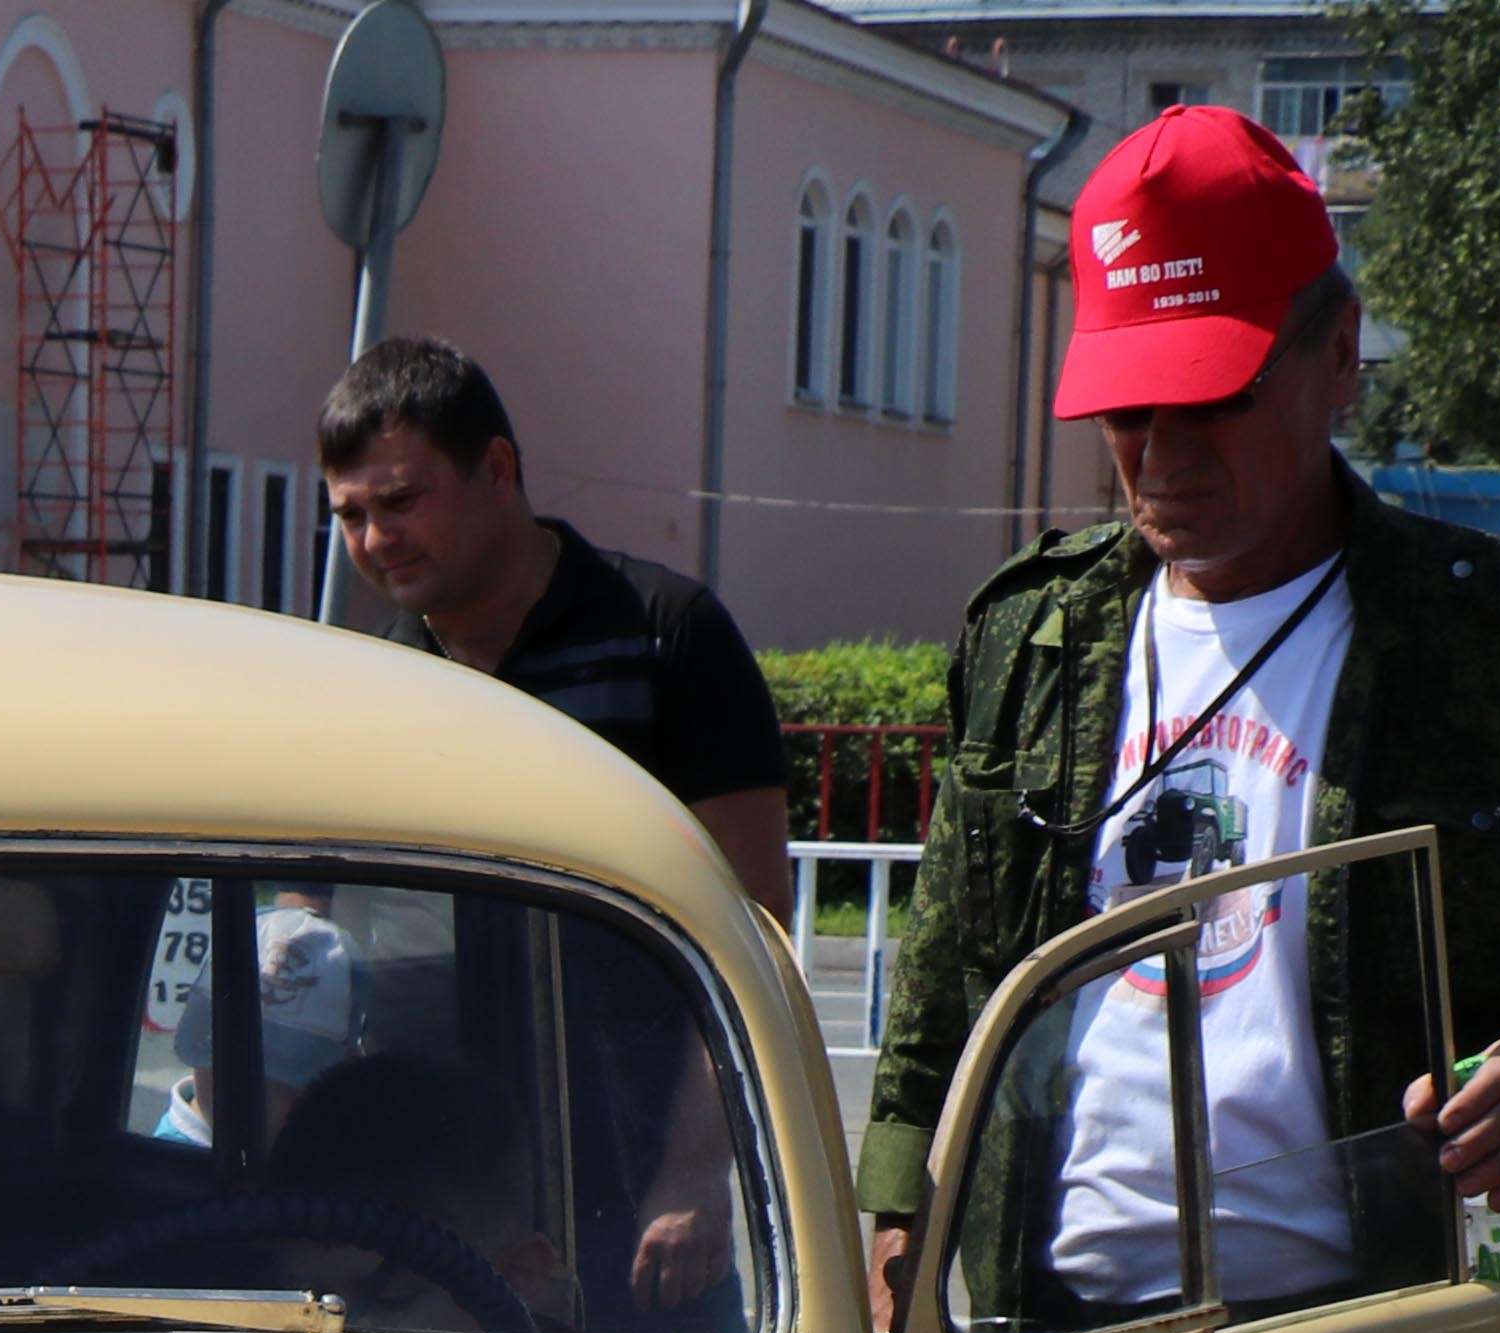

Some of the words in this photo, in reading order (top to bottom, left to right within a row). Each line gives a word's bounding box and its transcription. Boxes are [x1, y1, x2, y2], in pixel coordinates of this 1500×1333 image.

[1106, 266, 1138, 291] НАМ
[1139, 263, 1161, 285] 80
[1163, 257, 1204, 281] ЛЕТ!
[1152, 289, 1221, 310] 1939-2019
[163, 931, 209, 963] 78
[153, 980, 192, 1003] 12
